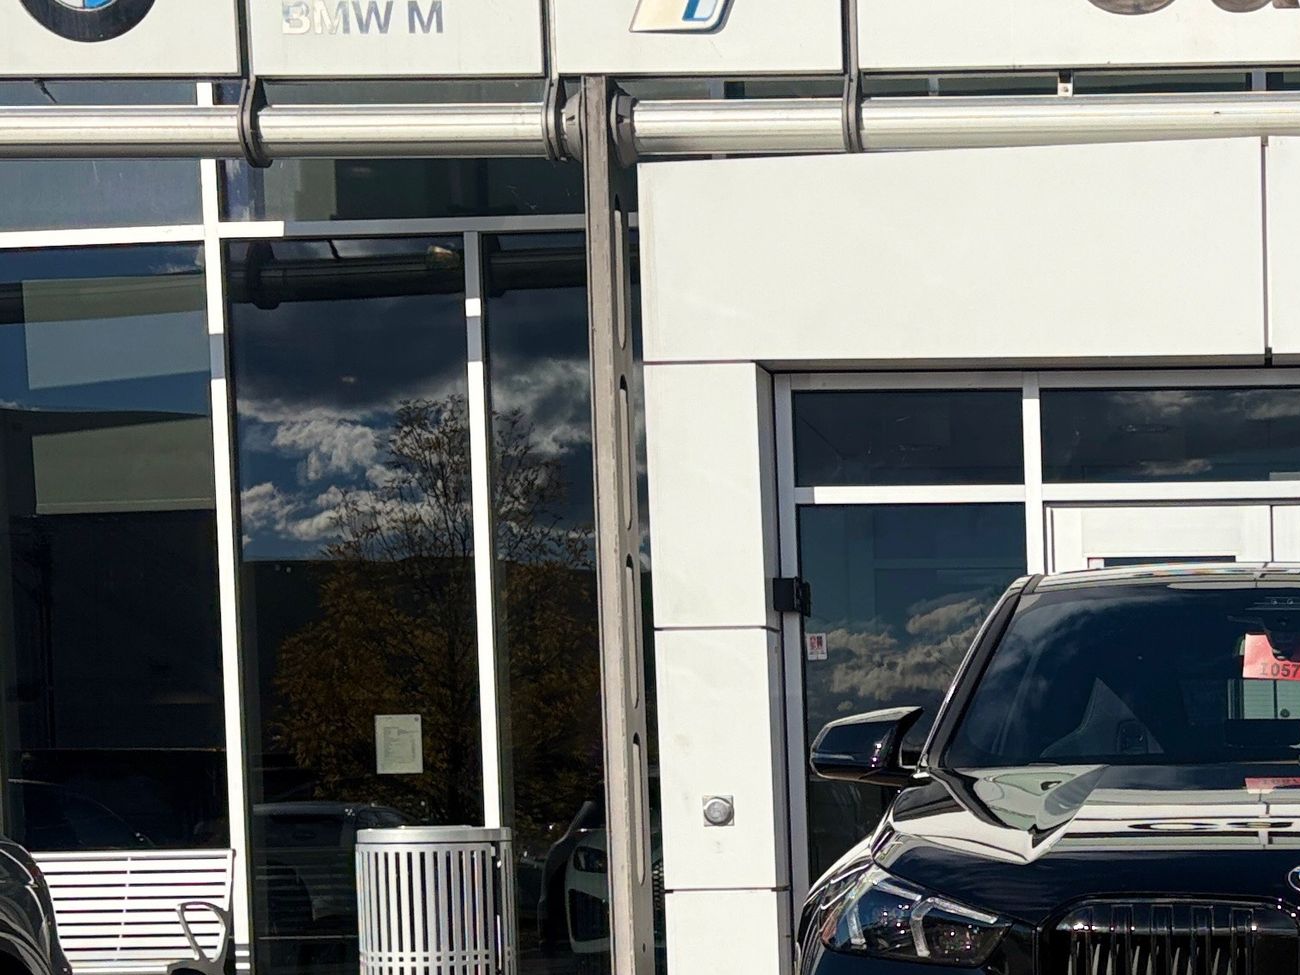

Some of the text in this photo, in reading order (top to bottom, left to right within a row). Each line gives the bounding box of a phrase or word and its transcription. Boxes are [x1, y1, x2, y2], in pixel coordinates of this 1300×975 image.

[282, 0, 444, 35] BMW M
[1260, 662, 1300, 678] 1057
